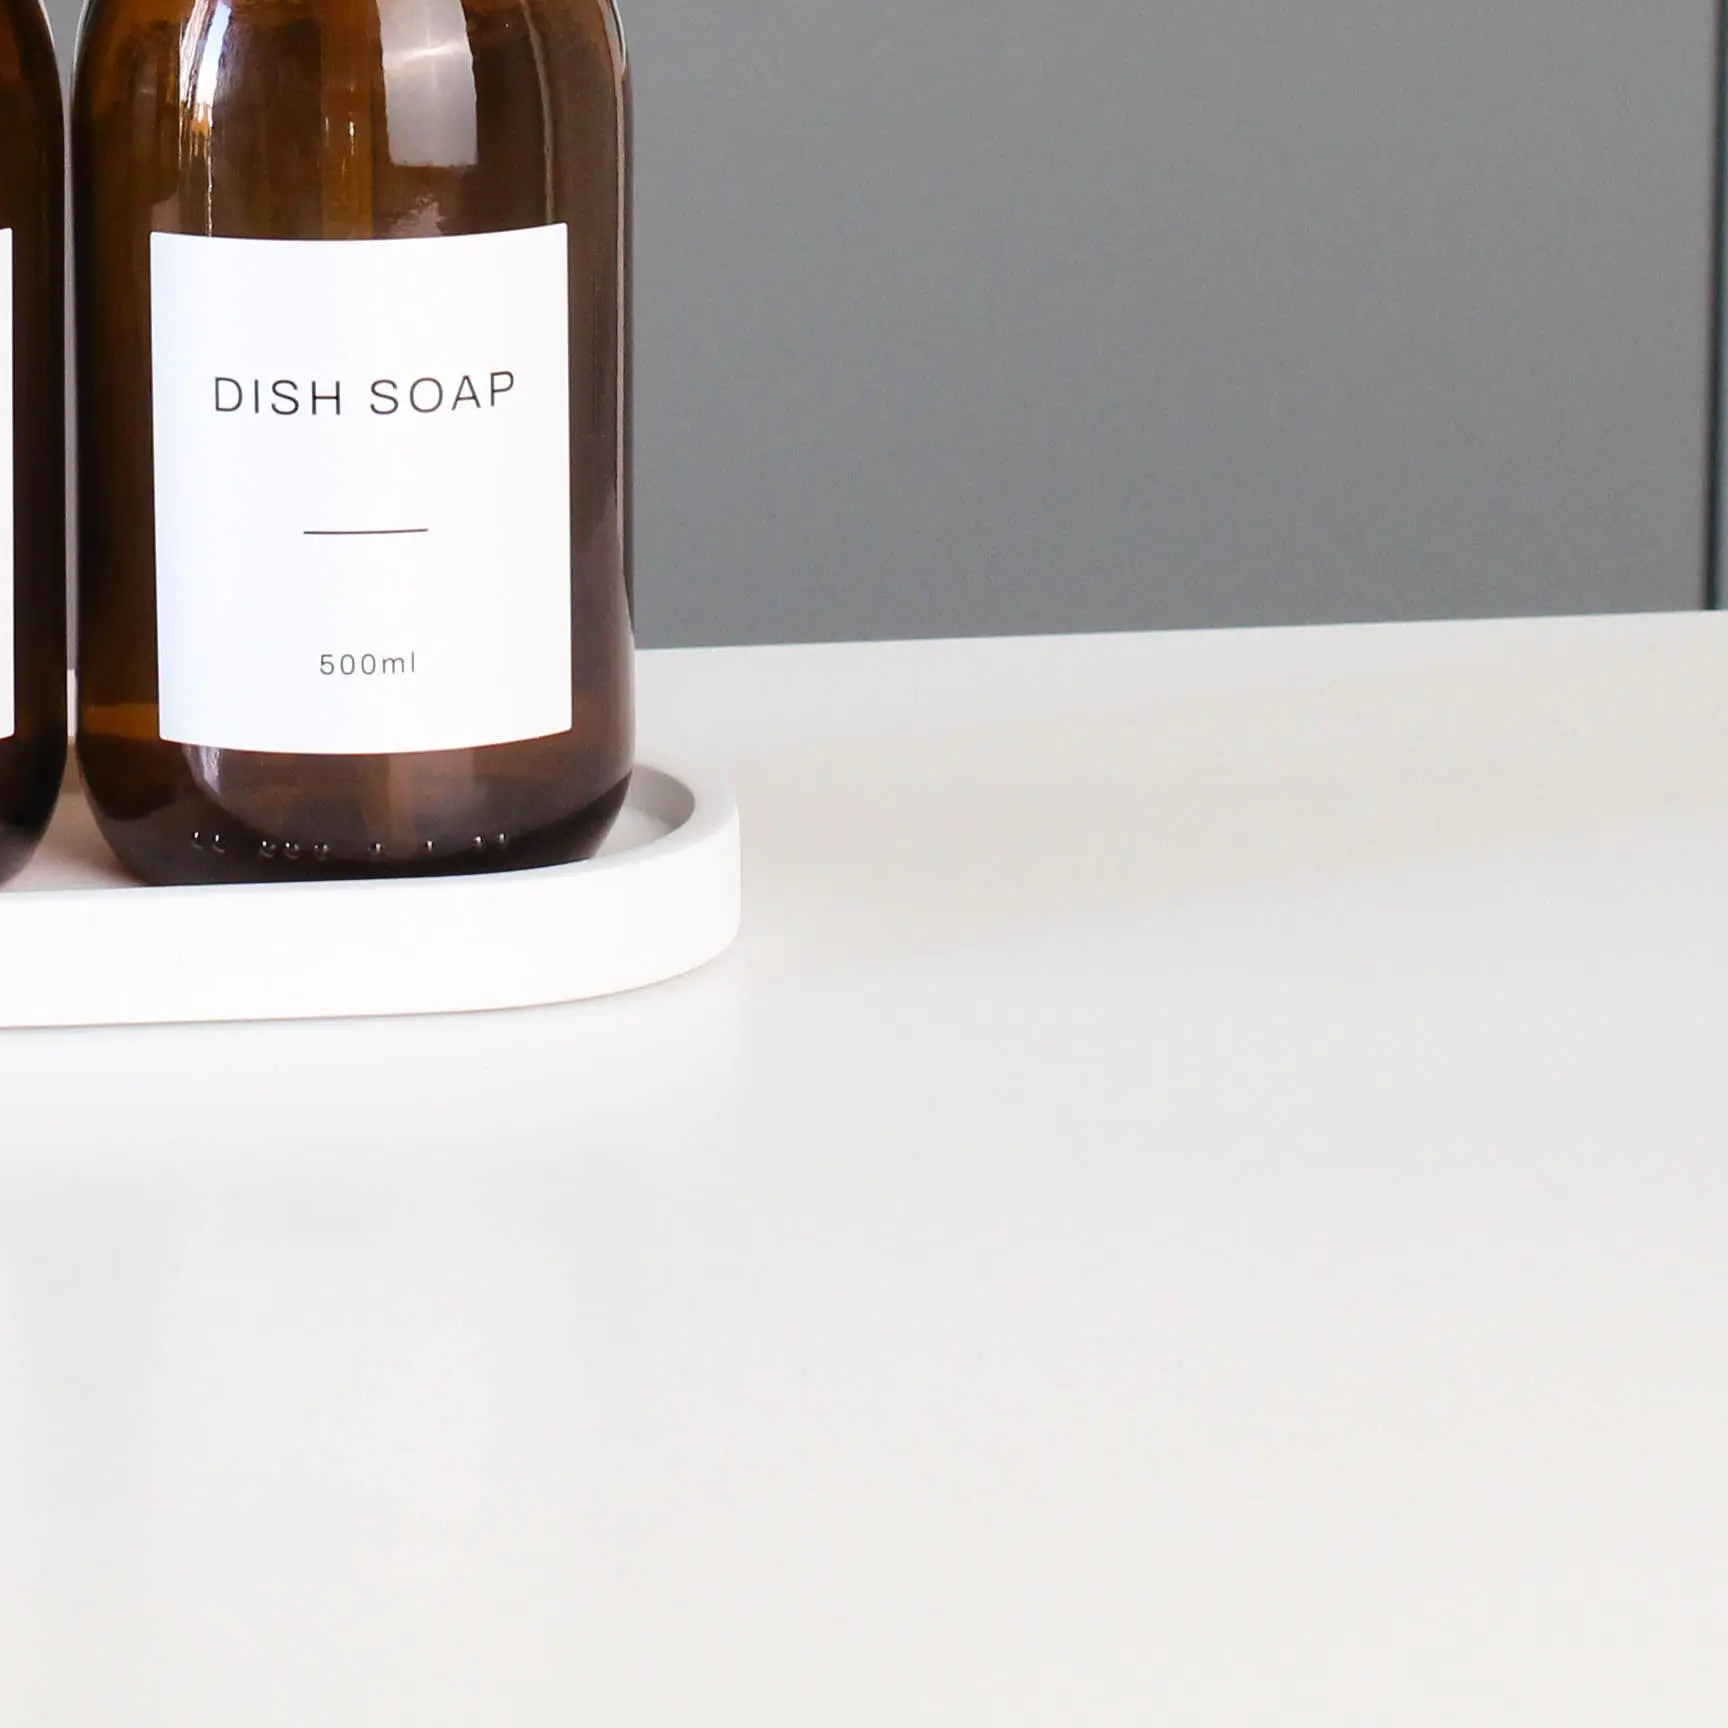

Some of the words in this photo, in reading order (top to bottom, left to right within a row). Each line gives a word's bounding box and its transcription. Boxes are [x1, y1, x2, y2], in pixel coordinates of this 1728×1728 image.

[213, 376, 342, 416] DISH
[369, 370, 515, 415] SOAP
[319, 653, 416, 676] 500ml
